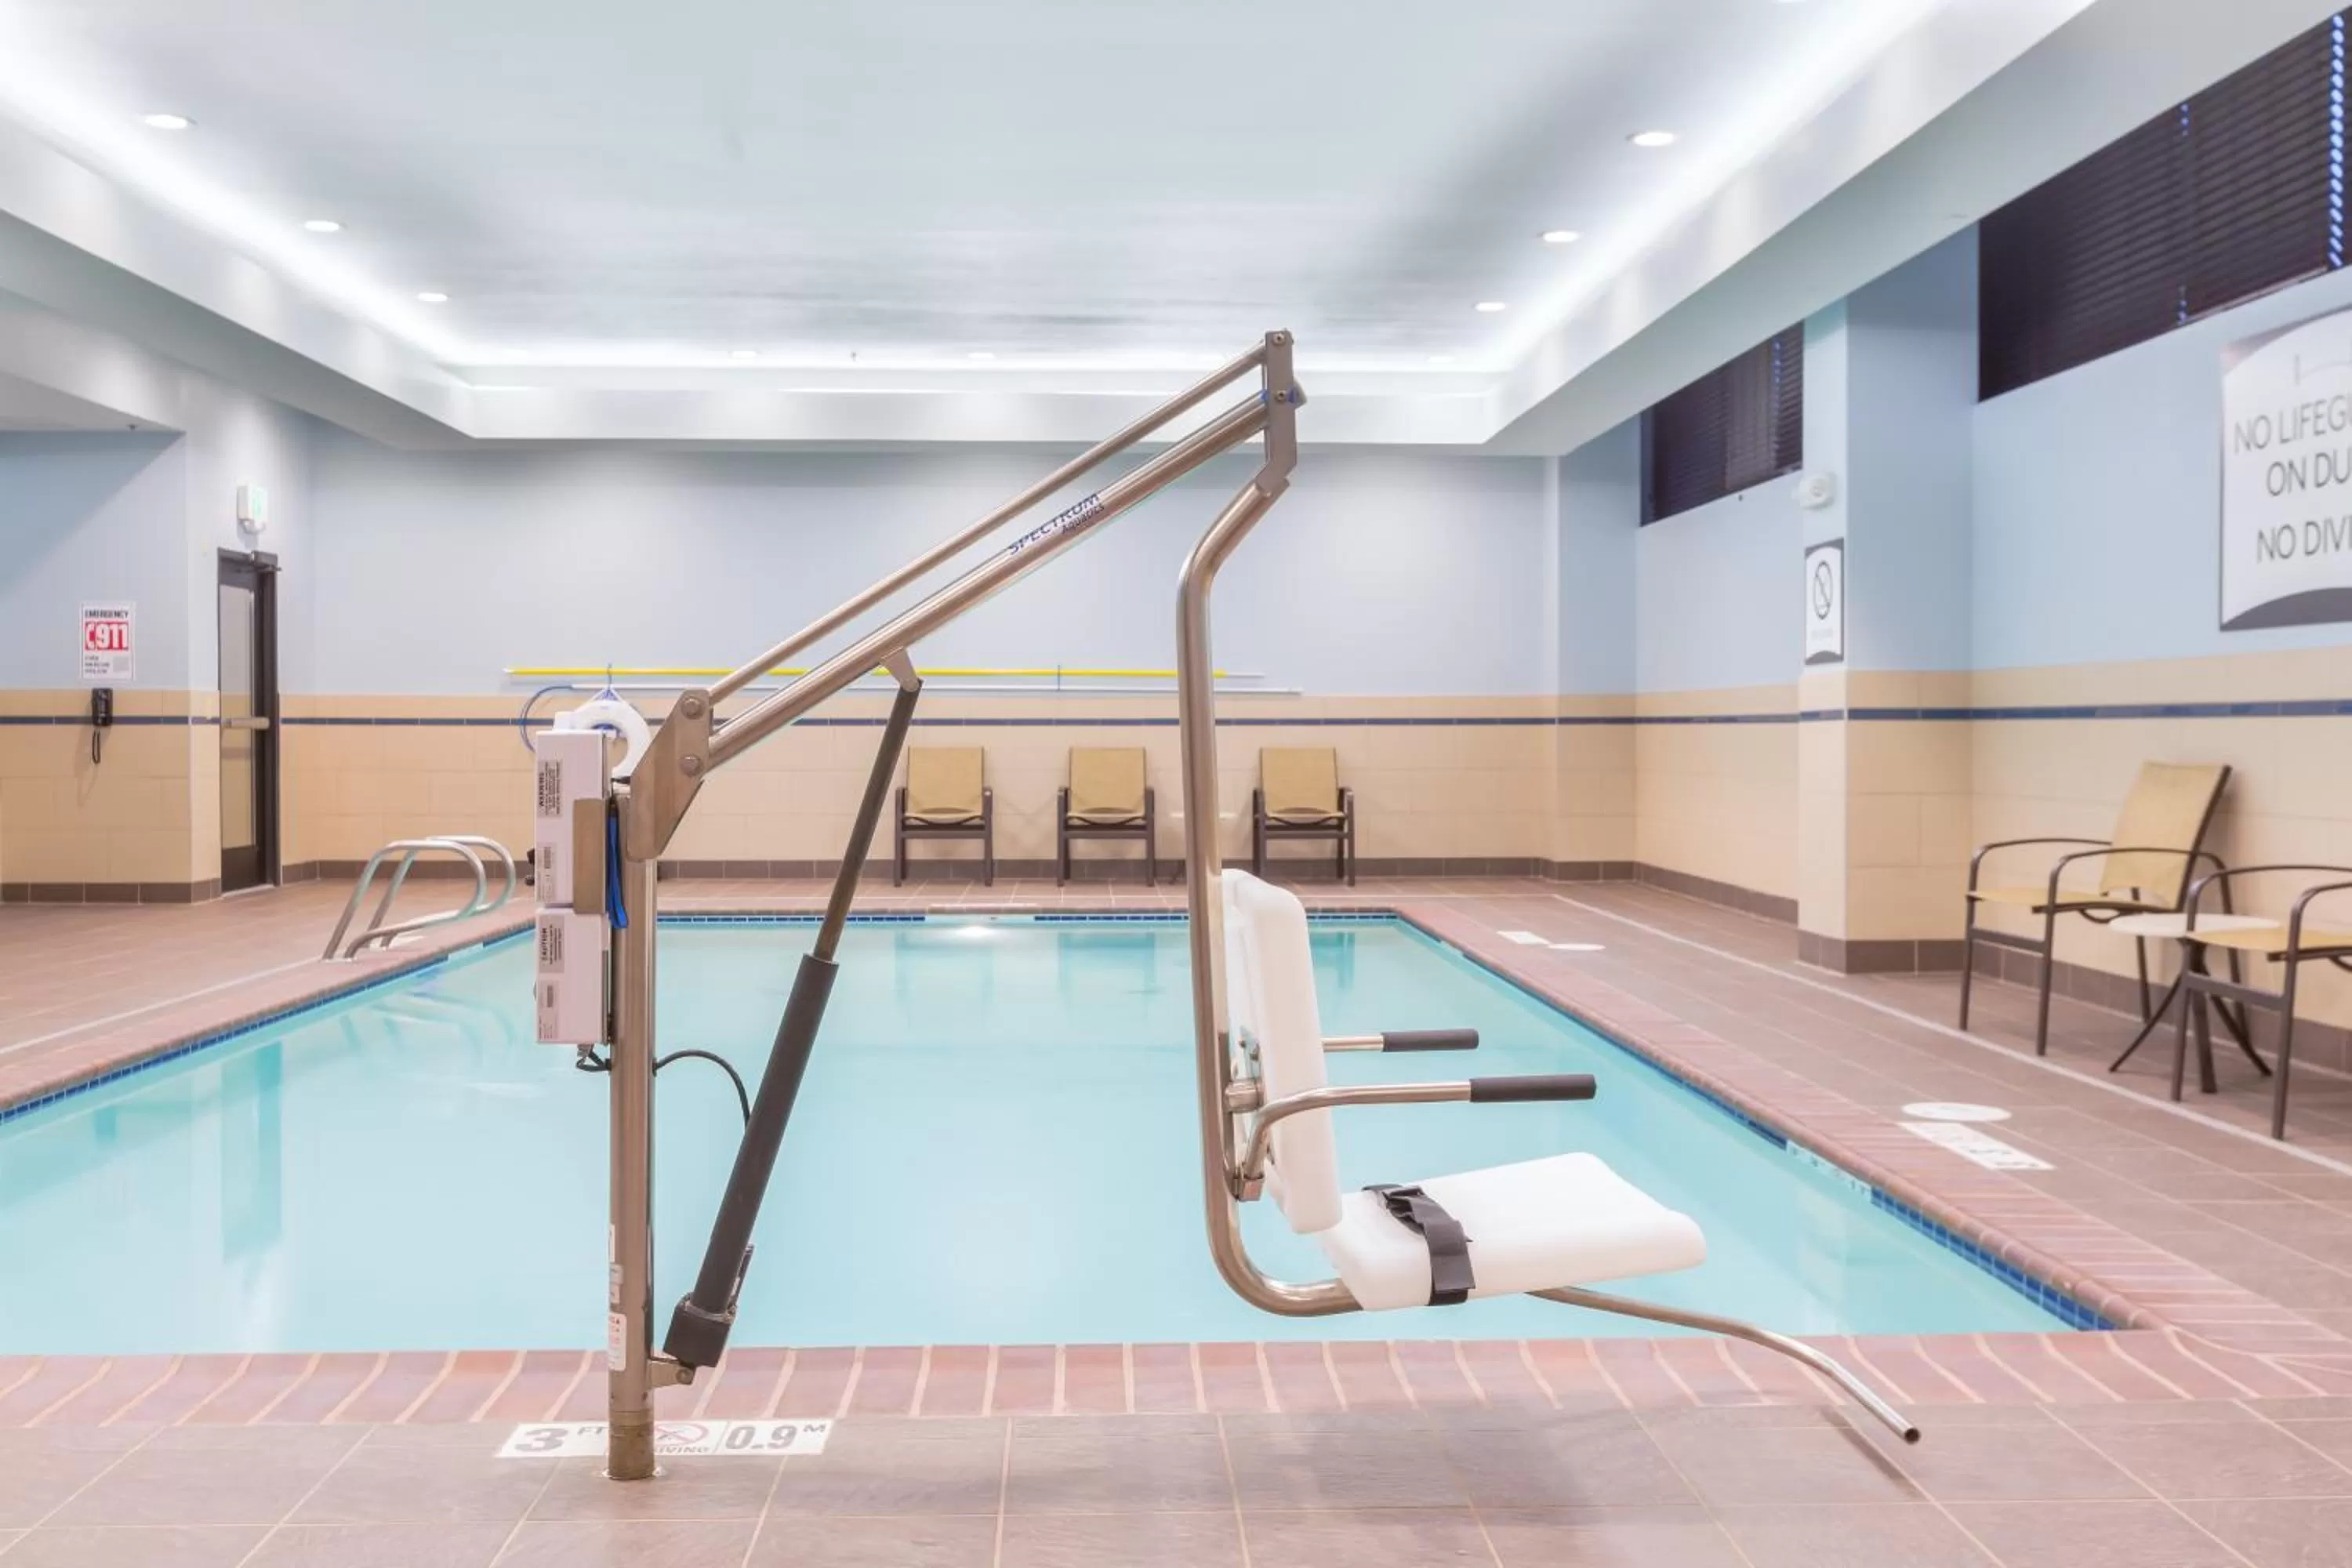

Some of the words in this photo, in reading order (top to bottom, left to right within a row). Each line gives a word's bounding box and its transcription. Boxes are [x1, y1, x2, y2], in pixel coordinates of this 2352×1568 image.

[2234, 415, 2271, 455] NO
[2279, 394, 2352, 444] LIFEG
[2266, 455, 2307, 496] ON
[1009, 493, 1098, 555] SPECTRUM
[2256, 524, 2297, 564] NO
[514, 1428, 568, 1453] 3
[653, 1444, 710, 1454] IVING
[725, 1425, 798, 1450] 0.9
